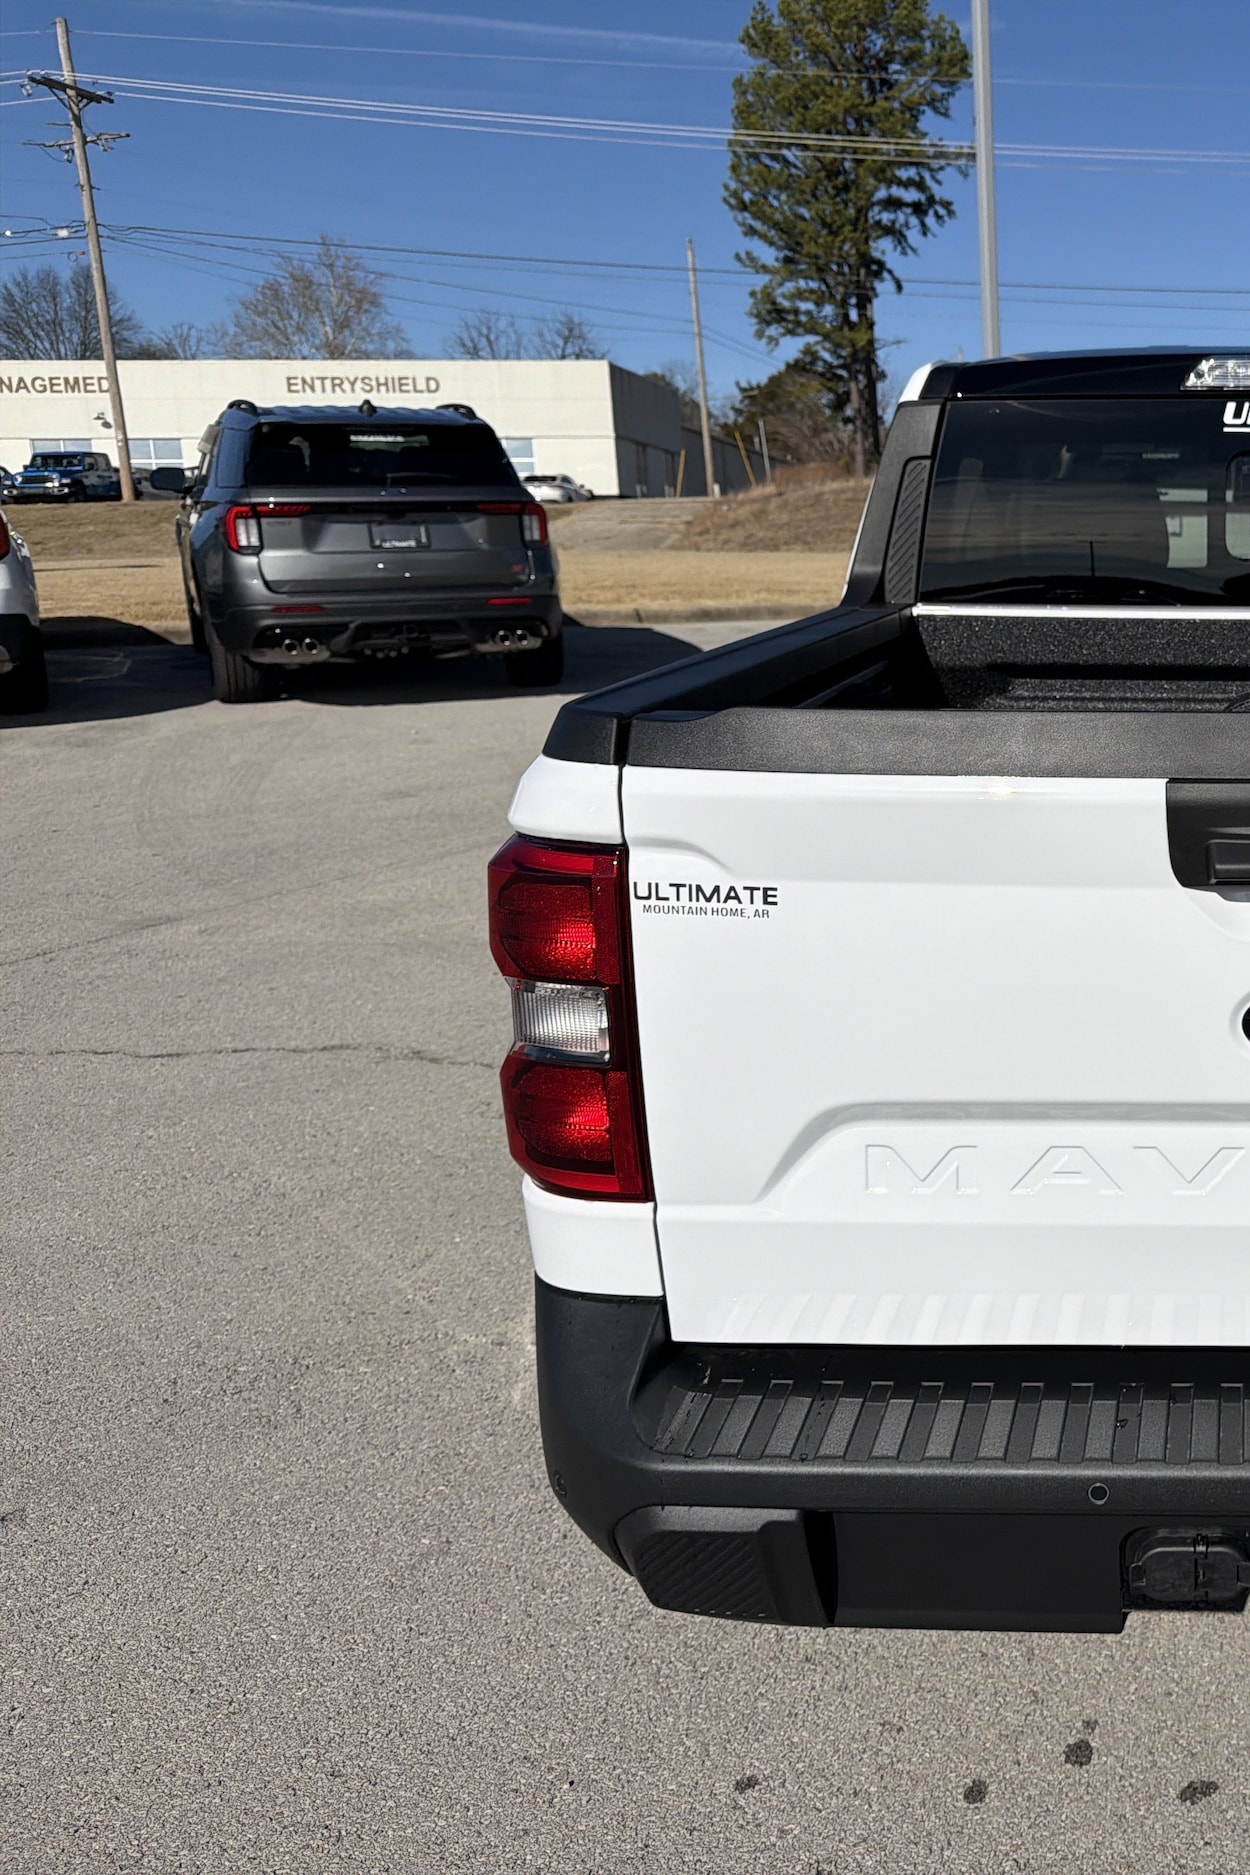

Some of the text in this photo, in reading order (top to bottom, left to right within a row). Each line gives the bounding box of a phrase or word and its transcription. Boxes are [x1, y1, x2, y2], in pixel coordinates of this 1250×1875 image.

[286, 376, 440, 394] ENTRYSHIELD
[633, 881, 778, 906] ULTIMATE
[642, 904, 770, 919] MOUNTAIN HOME, AR
